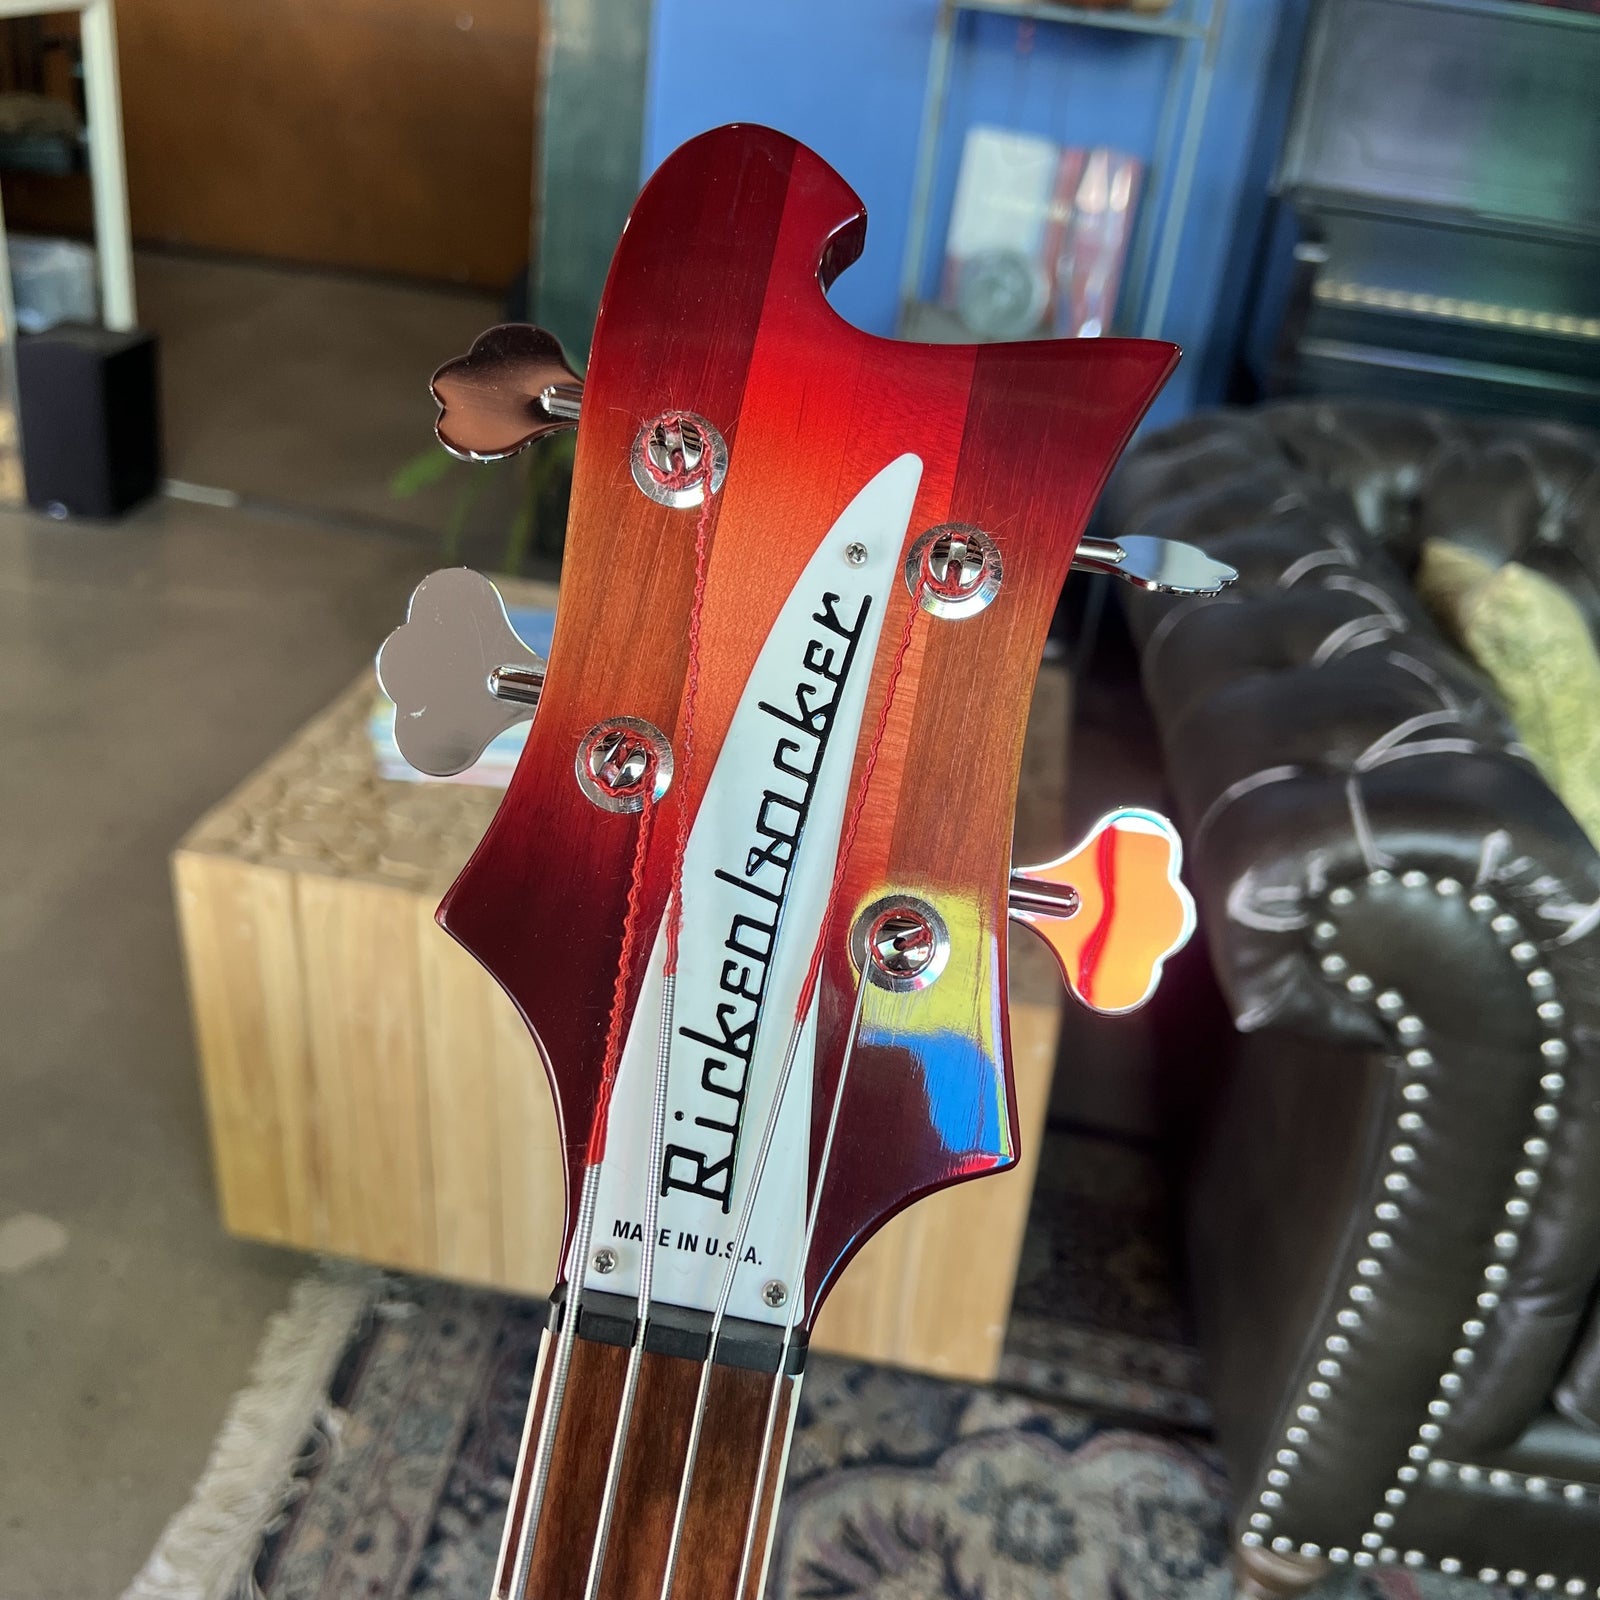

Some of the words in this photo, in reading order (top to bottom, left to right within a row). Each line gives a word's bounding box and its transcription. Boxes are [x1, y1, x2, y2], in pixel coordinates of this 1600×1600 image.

[660, 592, 873, 1214] Rickenbacker
[612, 1219, 672, 1247] MAE
[677, 1231, 699, 1252] IN
